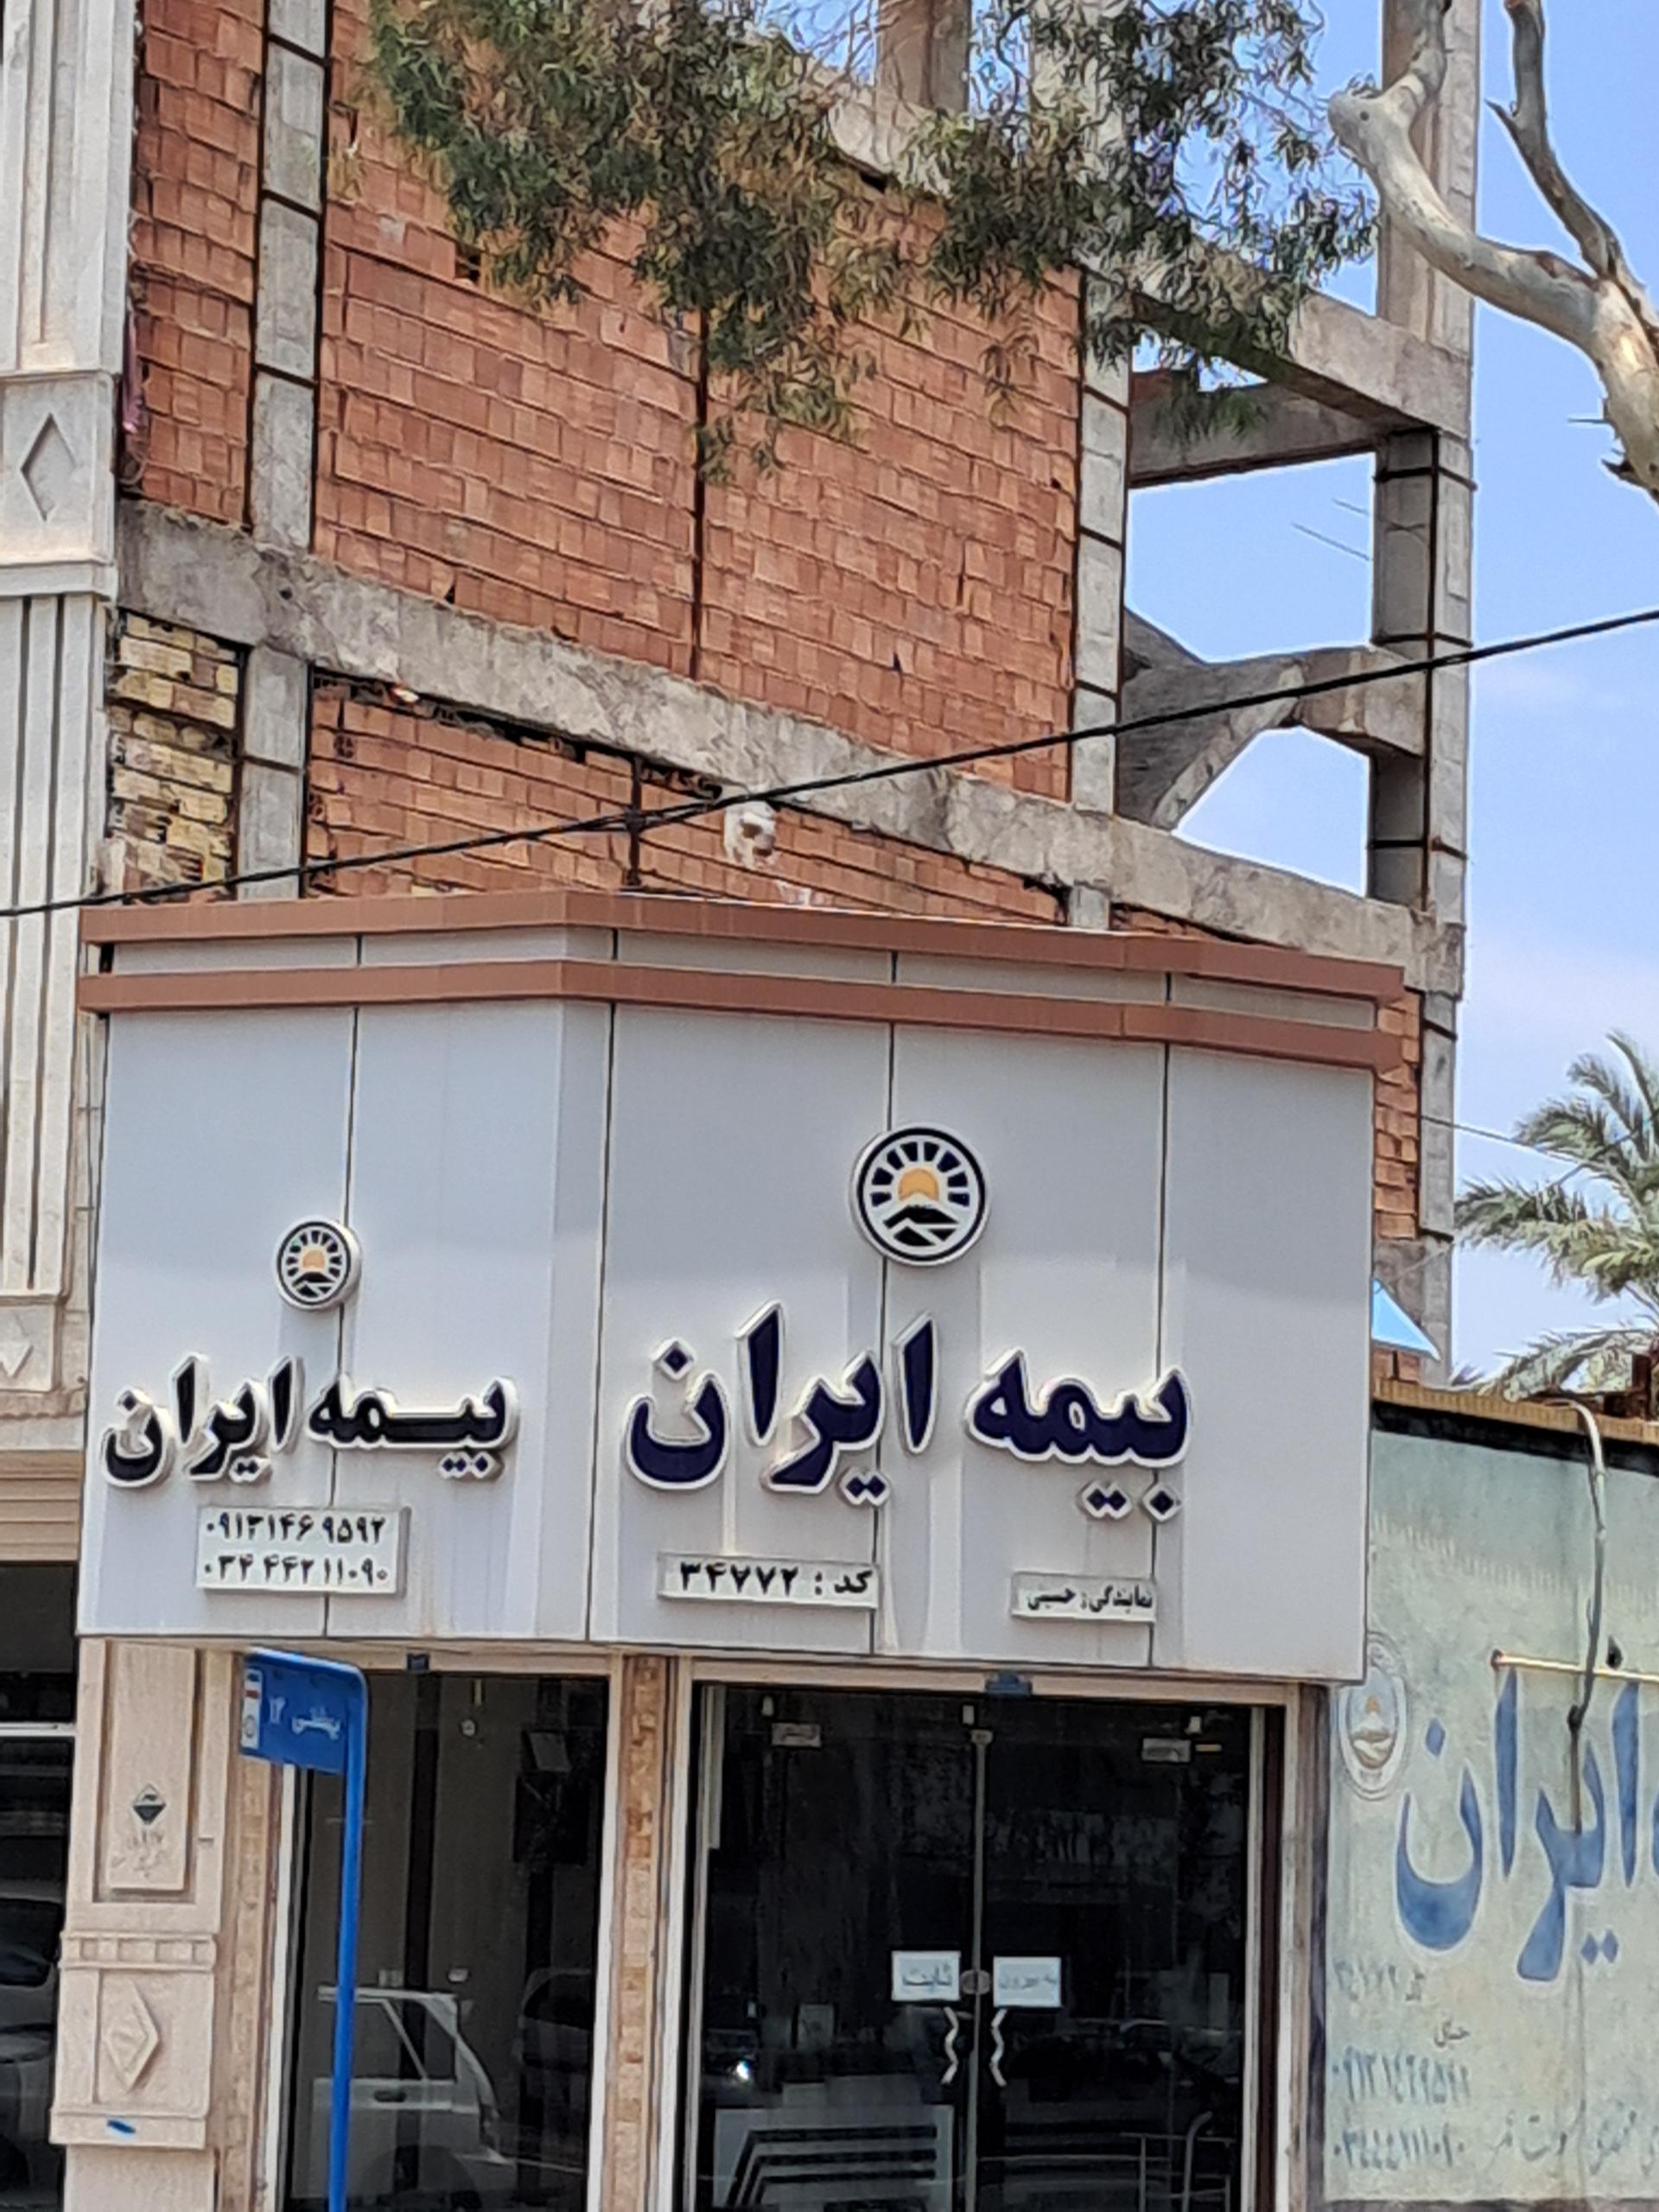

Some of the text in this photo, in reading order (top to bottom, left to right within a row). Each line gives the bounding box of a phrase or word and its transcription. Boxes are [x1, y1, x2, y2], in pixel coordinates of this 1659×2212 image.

[104, 1357, 507, 1482] بیمه ایران
[629, 1303, 1187, 1514] بیمه ایران
[680, 1560, 799, 1596] ۳۴۷۷۲
[1395, 1669, 1640, 1981] ایران
